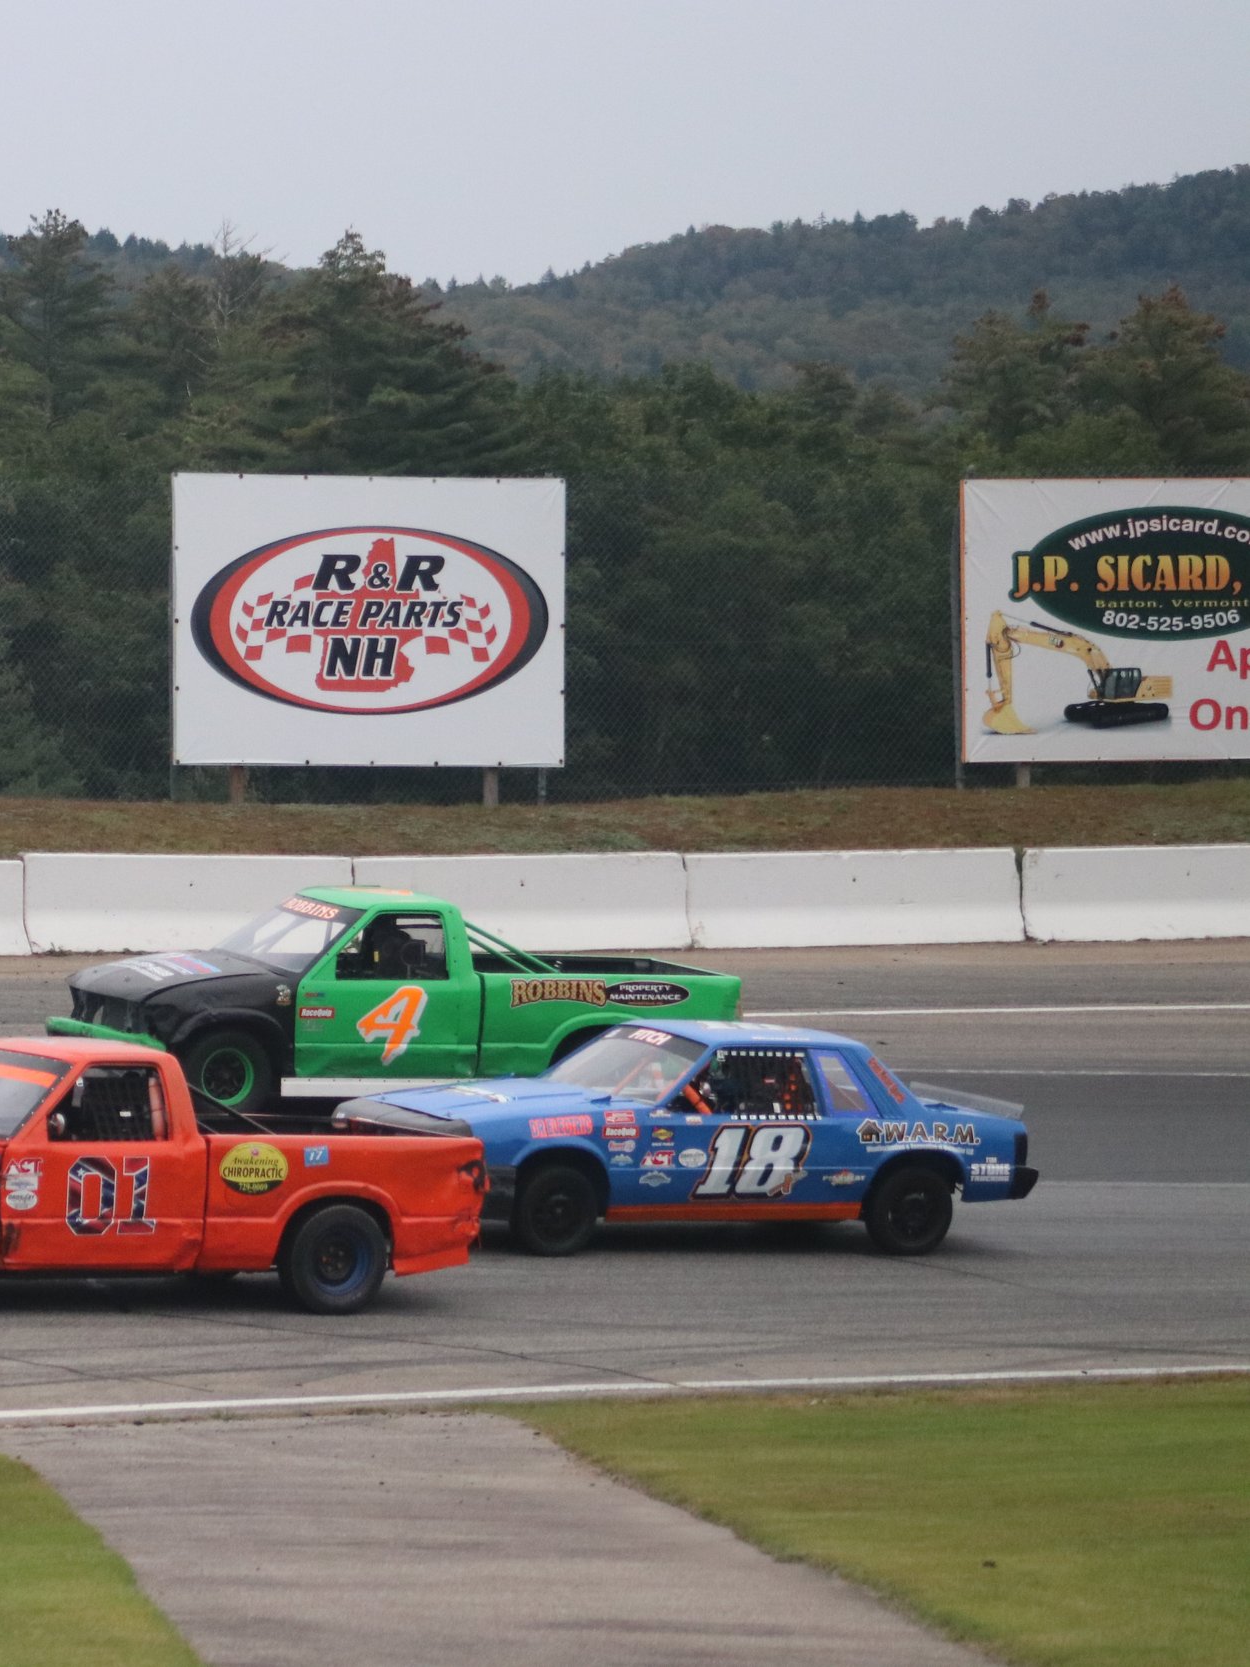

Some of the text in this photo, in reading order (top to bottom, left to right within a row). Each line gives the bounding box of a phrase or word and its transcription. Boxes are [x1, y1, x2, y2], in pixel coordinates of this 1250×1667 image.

[1068, 515, 1250, 551] www.jpsicard.co
[1013, 554, 1242, 598] J.P. SICARD,
[263, 600, 464, 629] RACE PARTS
[1171, 599, 1249, 608] Vermont
[1102, 609, 1240, 631] 802-525-9506
[325, 637, 398, 678] NH
[511, 979, 671, 1008] ROBBINS PROPERTY
[609, 993, 682, 1001] MAINTENANCE
[356, 985, 428, 1066] 4
[883, 1121, 981, 1145] W.A.R.M.
[5, 1157, 43, 1174] ACT
[222, 1166, 284, 1179] CHIROPRACTIC
[640, 1150, 675, 1167] ACT
[692, 1124, 810, 1197] 18
[66, 1155, 156, 1236] 01
